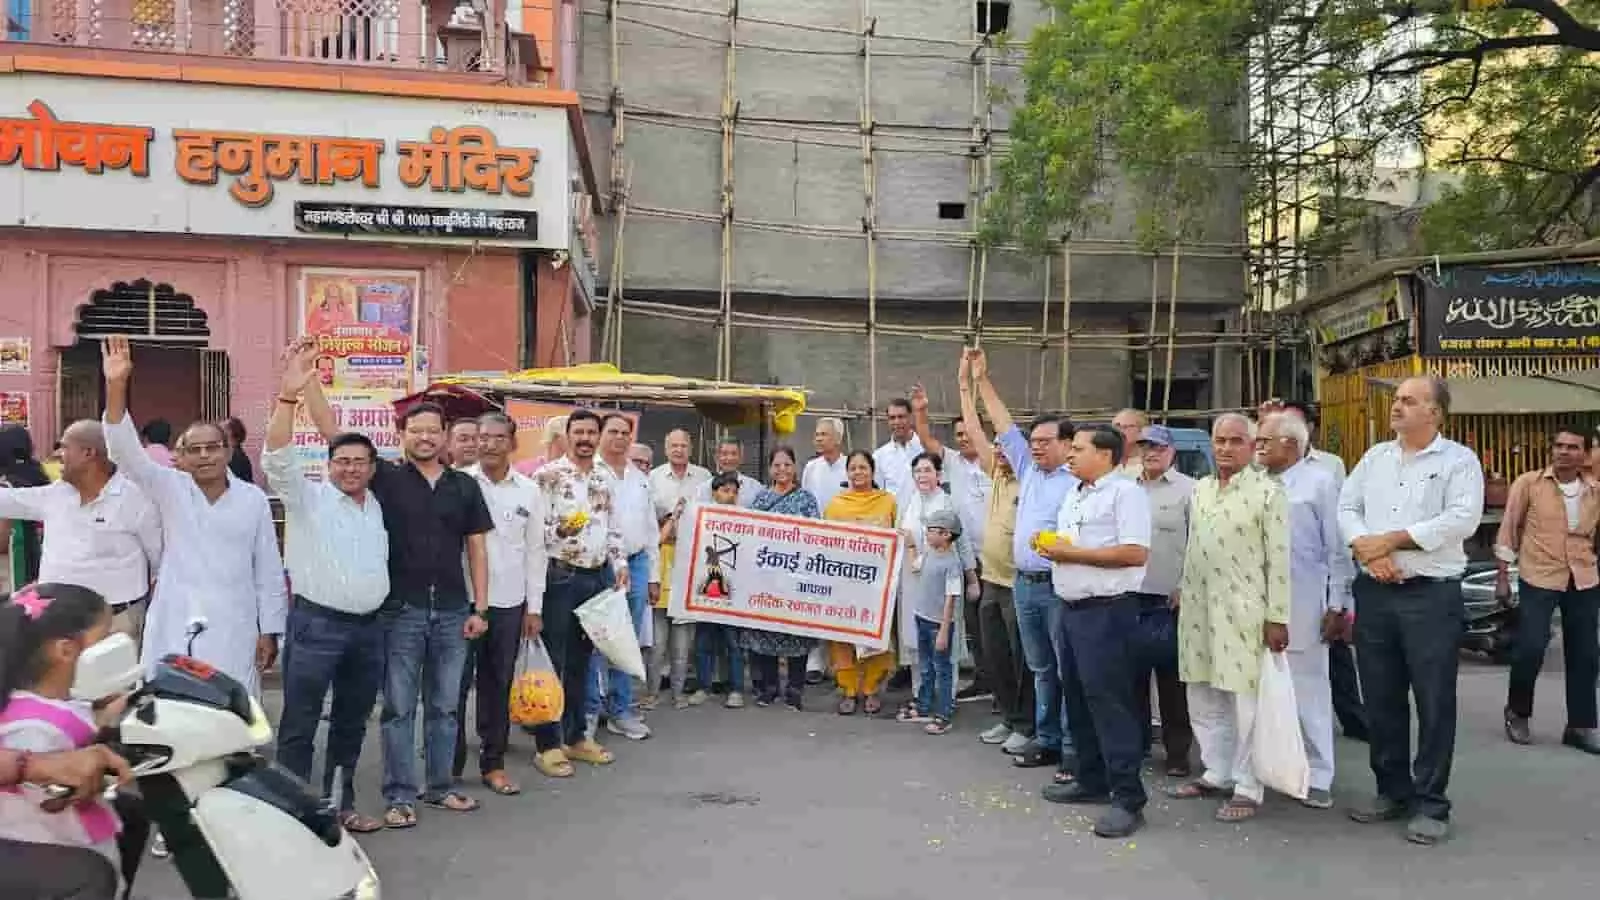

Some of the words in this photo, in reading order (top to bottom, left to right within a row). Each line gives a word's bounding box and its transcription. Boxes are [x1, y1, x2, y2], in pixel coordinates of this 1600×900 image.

[173, 128, 384, 208] हनुमान
[397, 126, 538, 197] मंदिर
[376, 208, 389, 225] श्री
[392, 209, 404, 226] श्री
[408, 213, 430, 227] 1008
[488, 216, 526, 232] महाराज
[705, 520, 754, 536] राजस्थान
[803, 533, 845, 550] कल्याण
[806, 552, 878, 585] भीलवाड़ा
[796, 582, 832, 597] आपका
